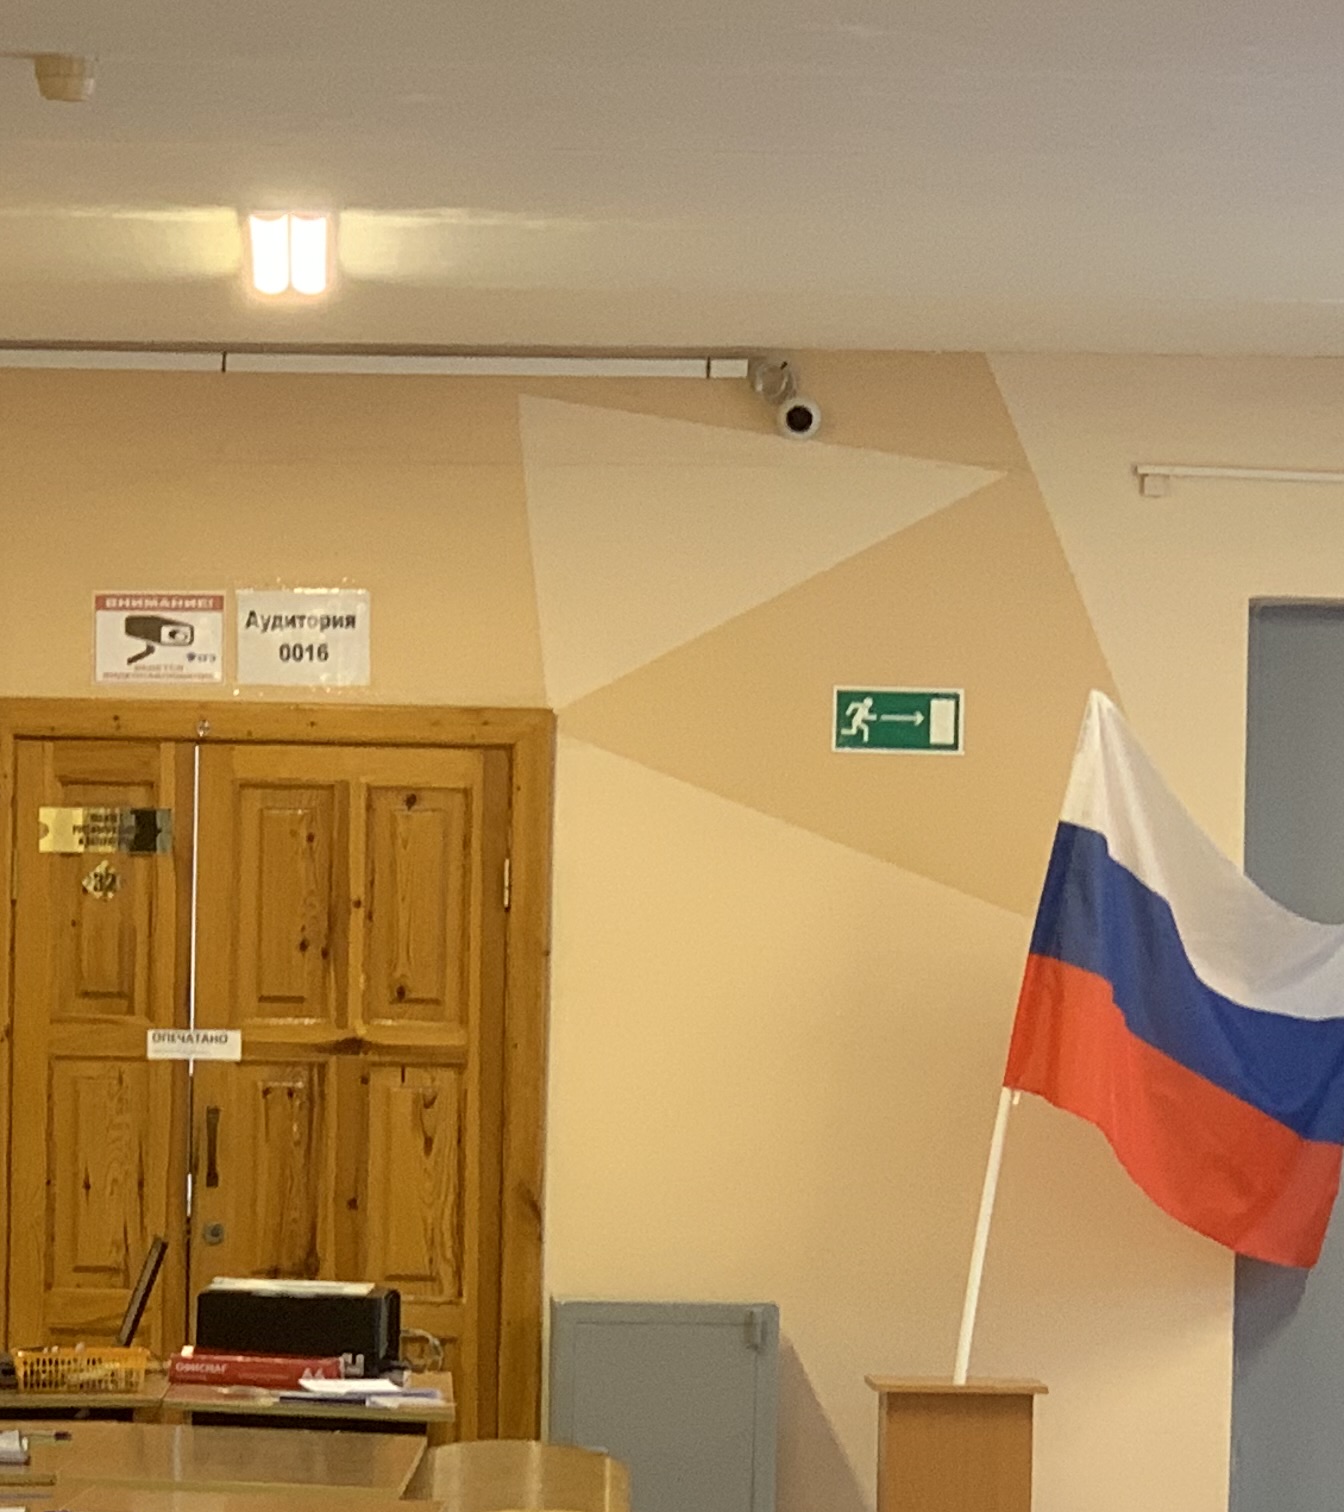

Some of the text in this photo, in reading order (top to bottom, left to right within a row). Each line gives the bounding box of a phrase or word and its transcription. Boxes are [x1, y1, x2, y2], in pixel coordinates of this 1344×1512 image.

[104, 597, 214, 609] ВНИМАНИЕ!
[245, 610, 357, 635] Аудитория
[278, 643, 330, 663] 0016
[152, 1032, 228, 1044] ОПЕЧАТАНО
